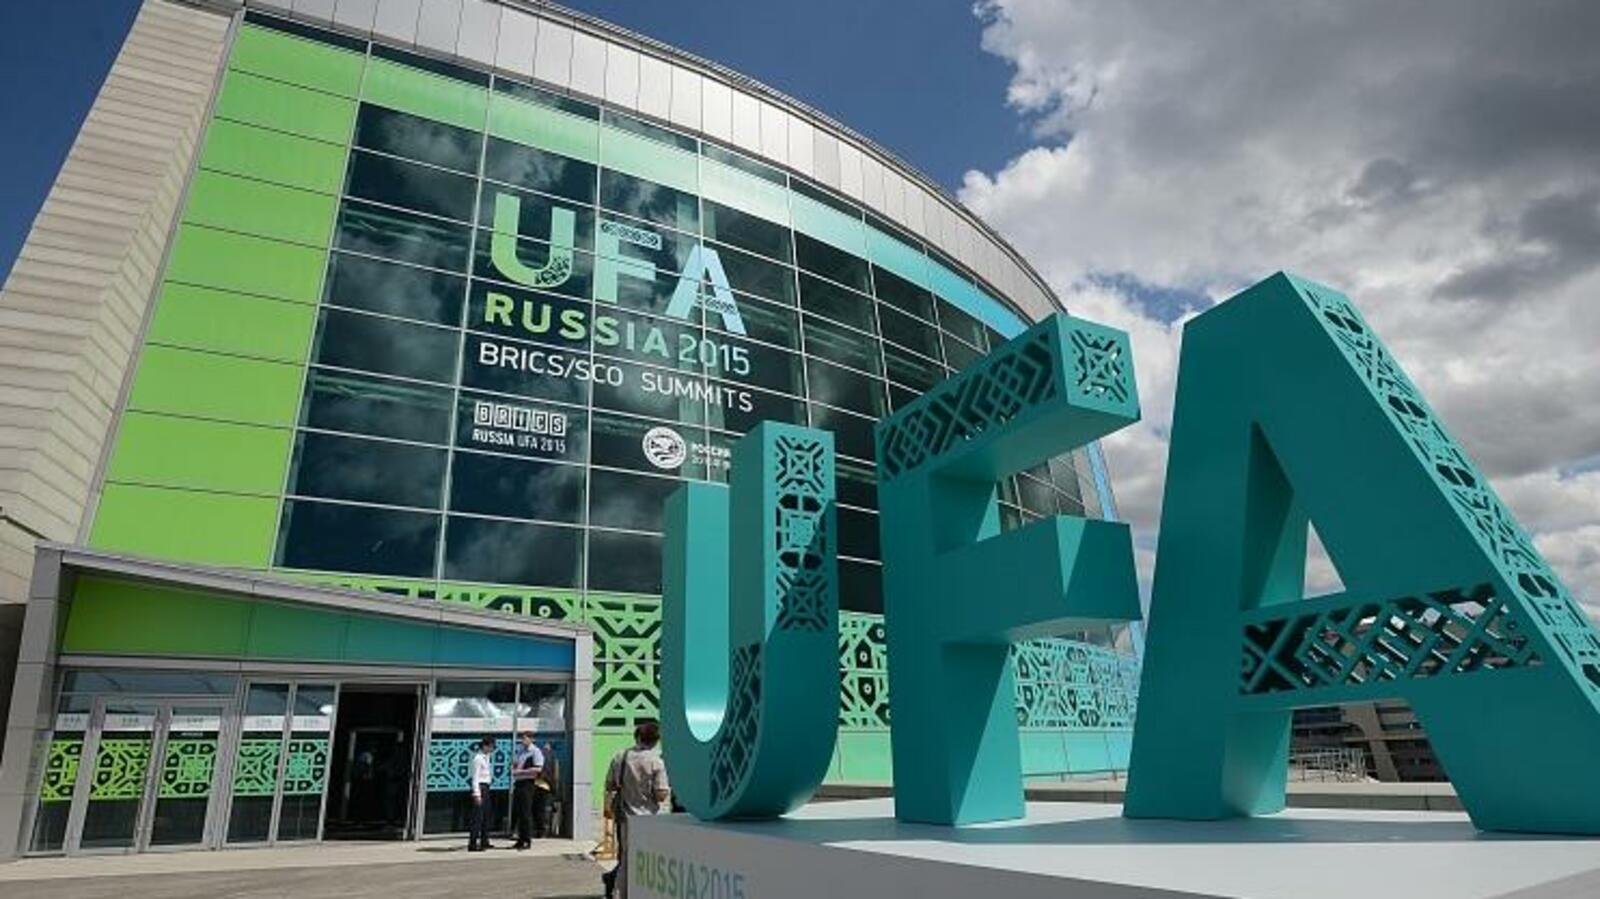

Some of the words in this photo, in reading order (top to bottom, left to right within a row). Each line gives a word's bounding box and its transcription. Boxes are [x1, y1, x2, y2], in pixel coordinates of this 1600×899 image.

[490, 192, 747, 335] UFA
[484, 291, 670, 358] RUSSIA
[678, 333, 751, 376] 2015
[478, 341, 624, 386] BRICS/SCO
[640, 371, 753, 412] SUMMITS
[472, 428, 514, 446] RUSSIA
[517, 434, 538, 449] UFA
[540, 437, 566, 454] 2015
[477, 403, 564, 434] BRICS
[662, 270, 1600, 834] UFA
